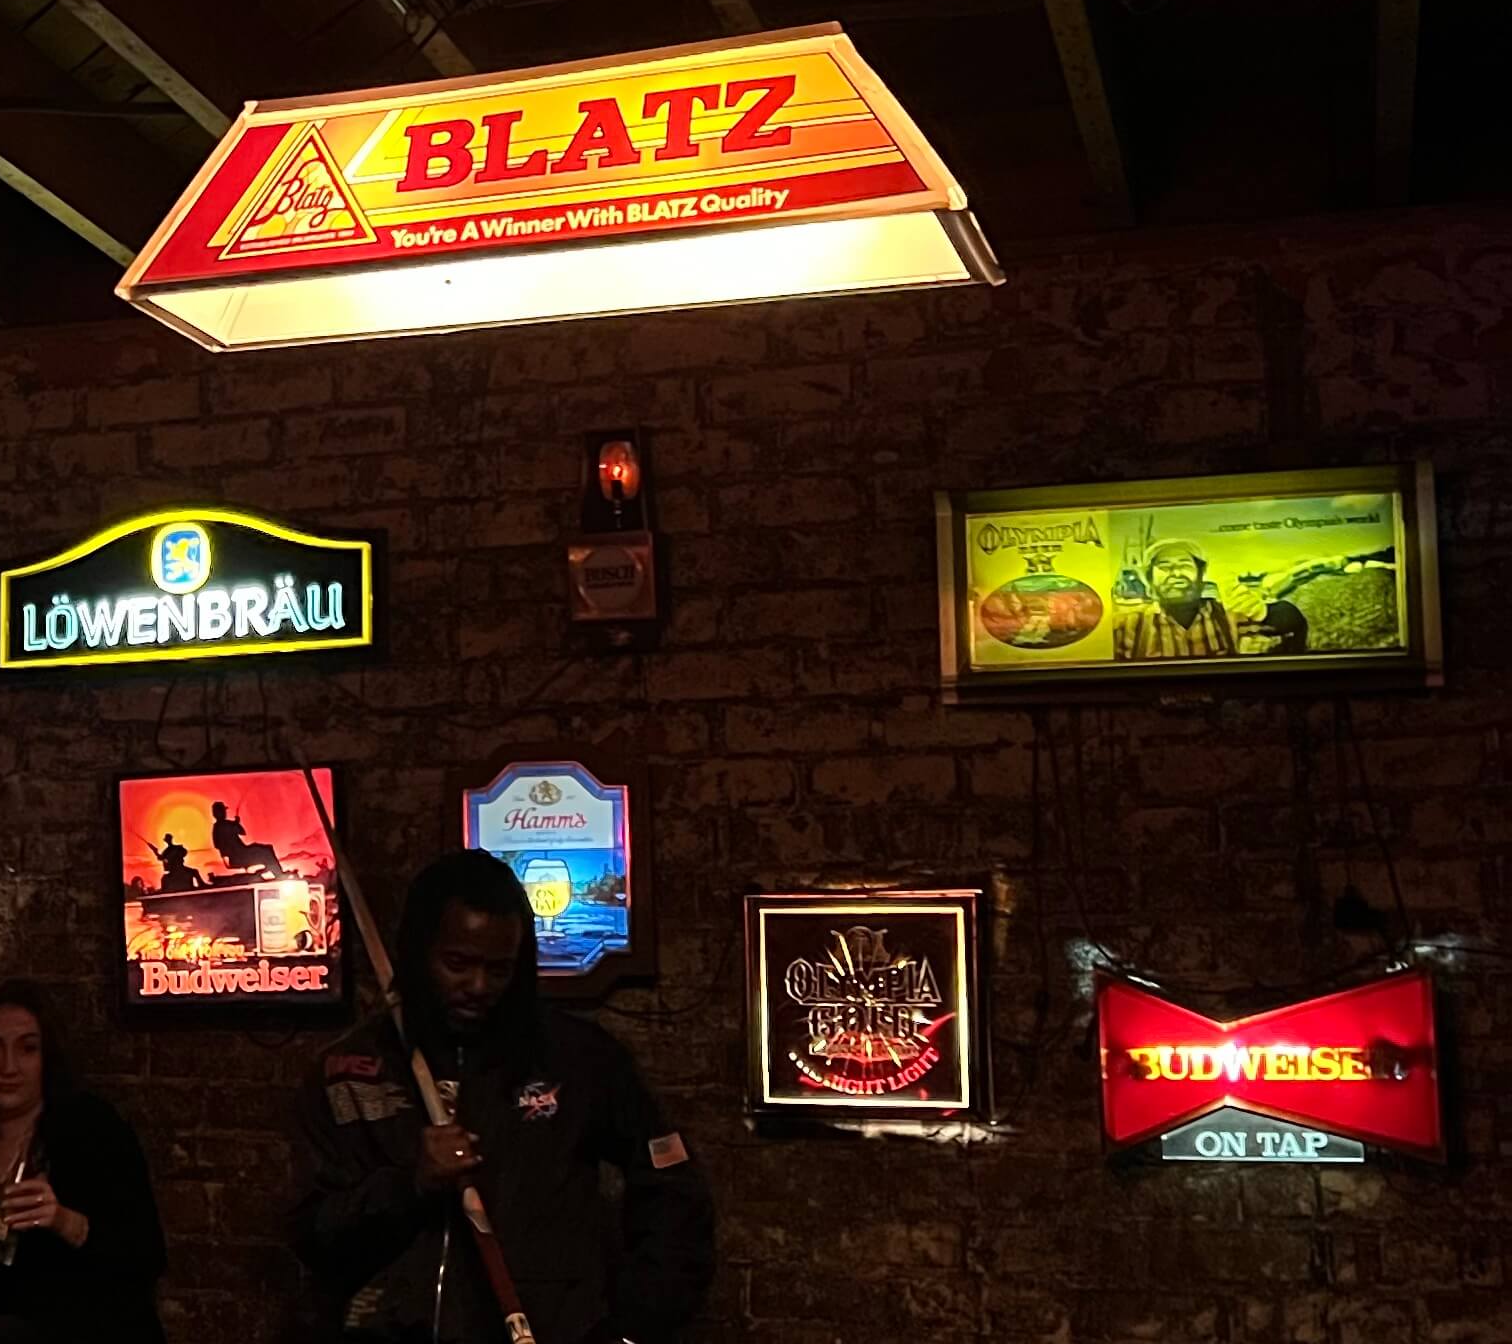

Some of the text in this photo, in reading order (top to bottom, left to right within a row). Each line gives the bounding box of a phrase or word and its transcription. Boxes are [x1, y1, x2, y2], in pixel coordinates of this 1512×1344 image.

[396, 74, 796, 193] BLATZ
[264, 162, 336, 229] Blatz
[390, 187, 790, 249] You're A Winner With BLATZ Quality
[976, 516, 1105, 556] OLYMPIA
[22, 573, 346, 652] LÖWENBRÄU
[503, 806, 587, 831] Hamm's
[139, 959, 329, 996] Budweiser
[1195, 1131, 1329, 1157] ON TAP
